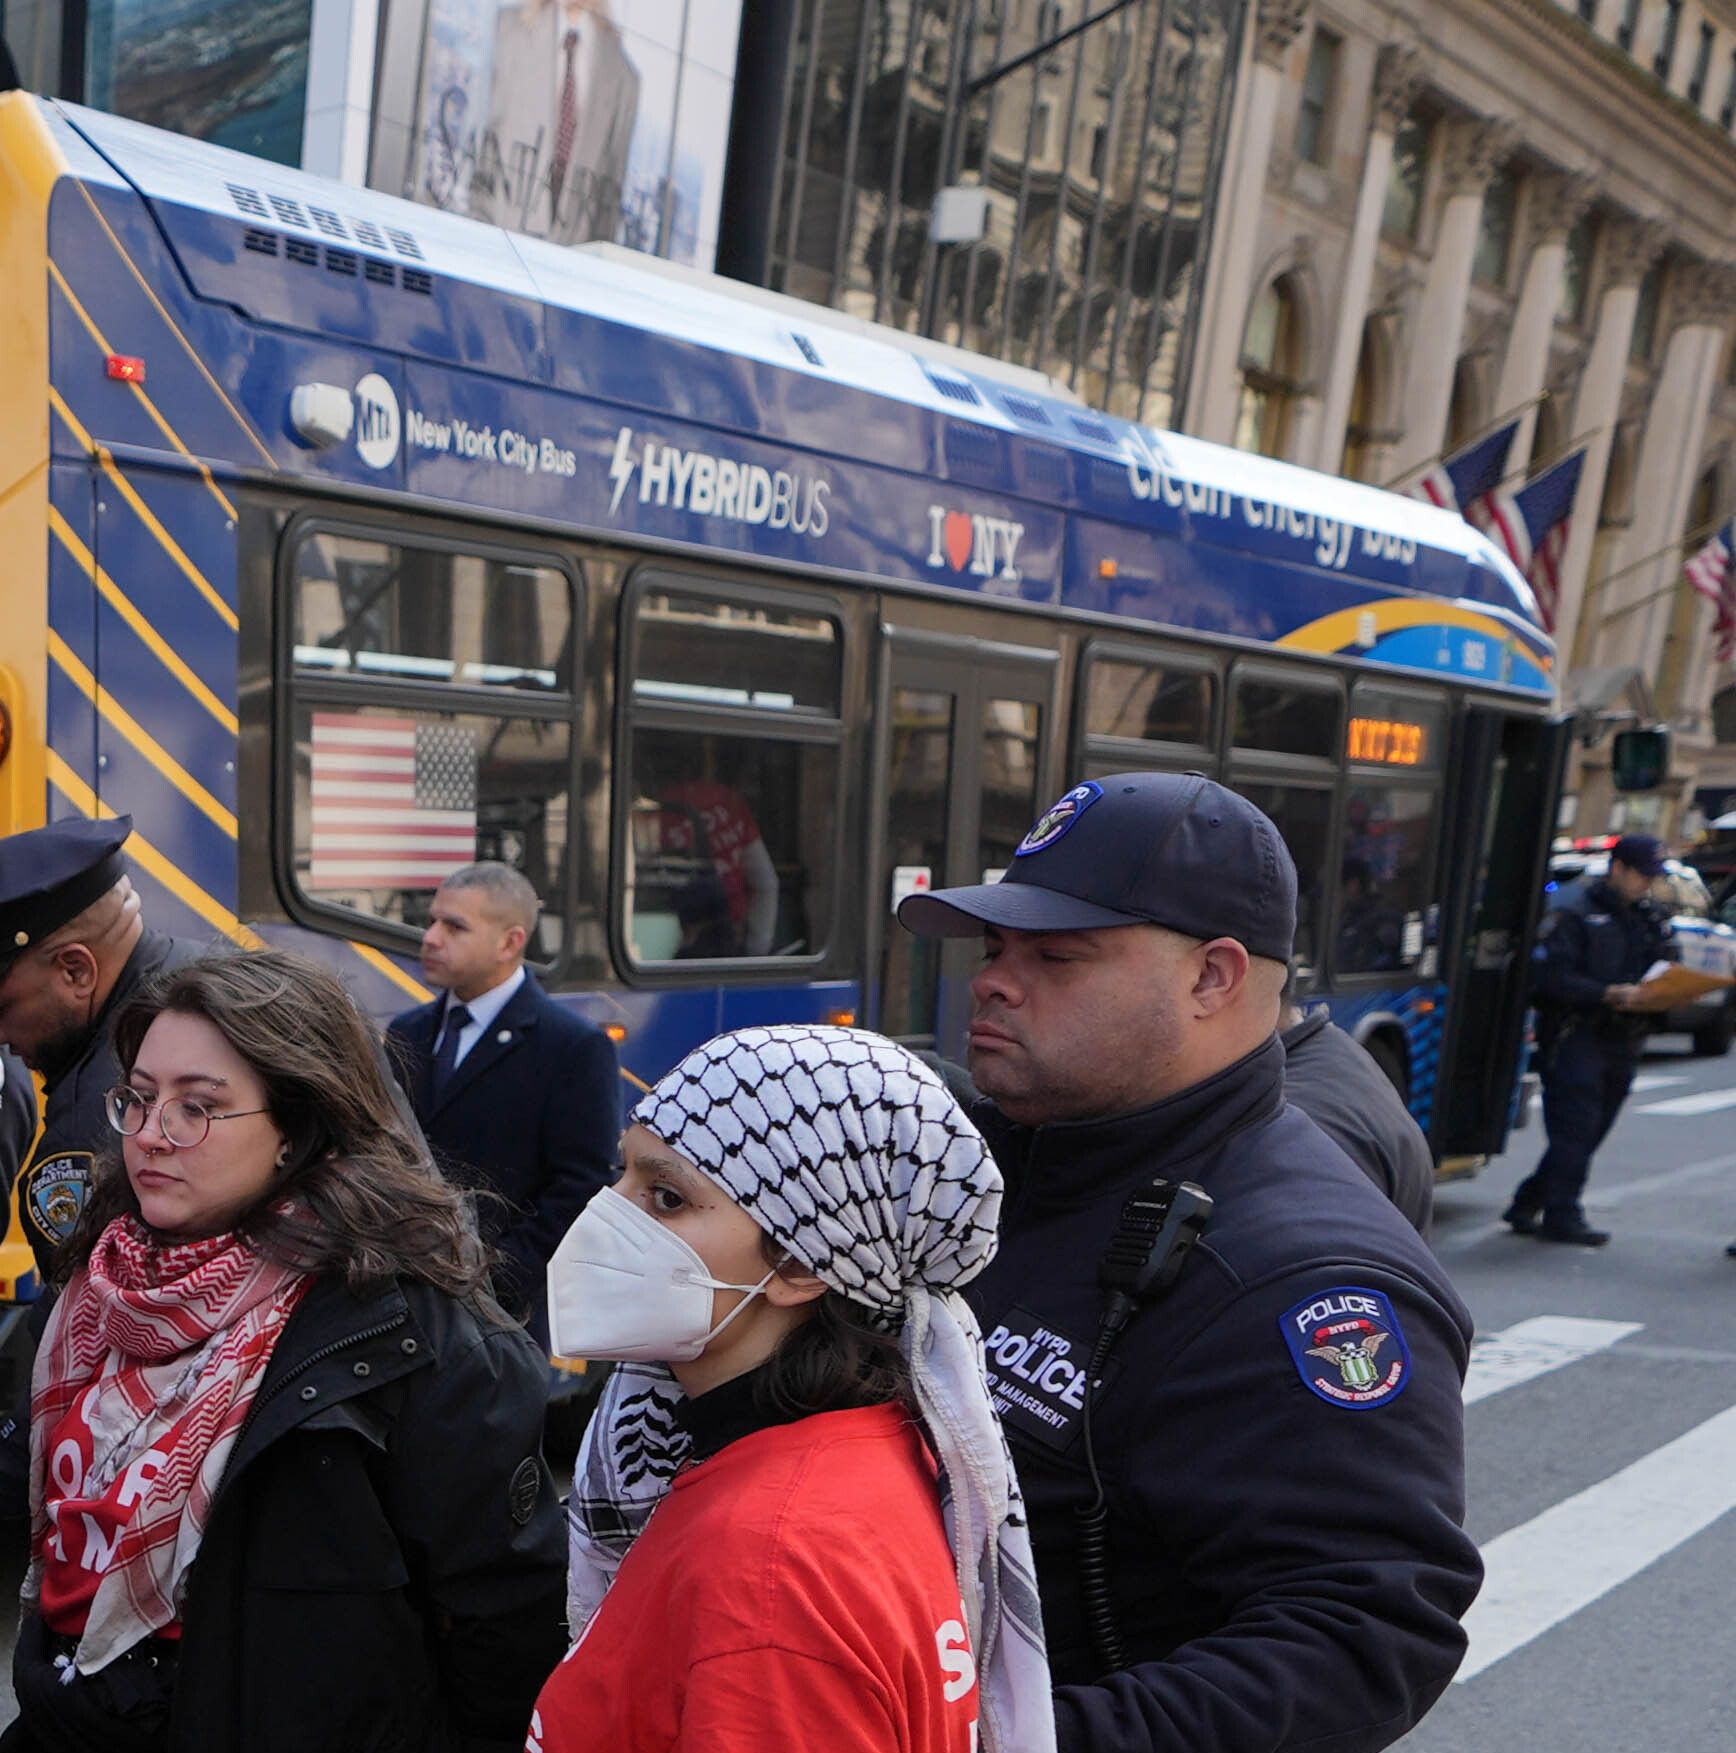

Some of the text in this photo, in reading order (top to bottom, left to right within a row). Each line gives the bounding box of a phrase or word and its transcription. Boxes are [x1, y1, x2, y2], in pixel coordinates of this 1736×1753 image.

[406, 409, 577, 477] New York City Bus
[1118, 437, 1232, 520] clean
[927, 505, 1025, 581] I NY
[1030, 1327, 1072, 1357] NYPD
[1296, 1295, 1381, 1334] POLICE
[1328, 1320, 1360, 1336] NYPD
[984, 1325, 1087, 1411] POLICE
[996, 1380, 1069, 1430] MANAGEMENT
